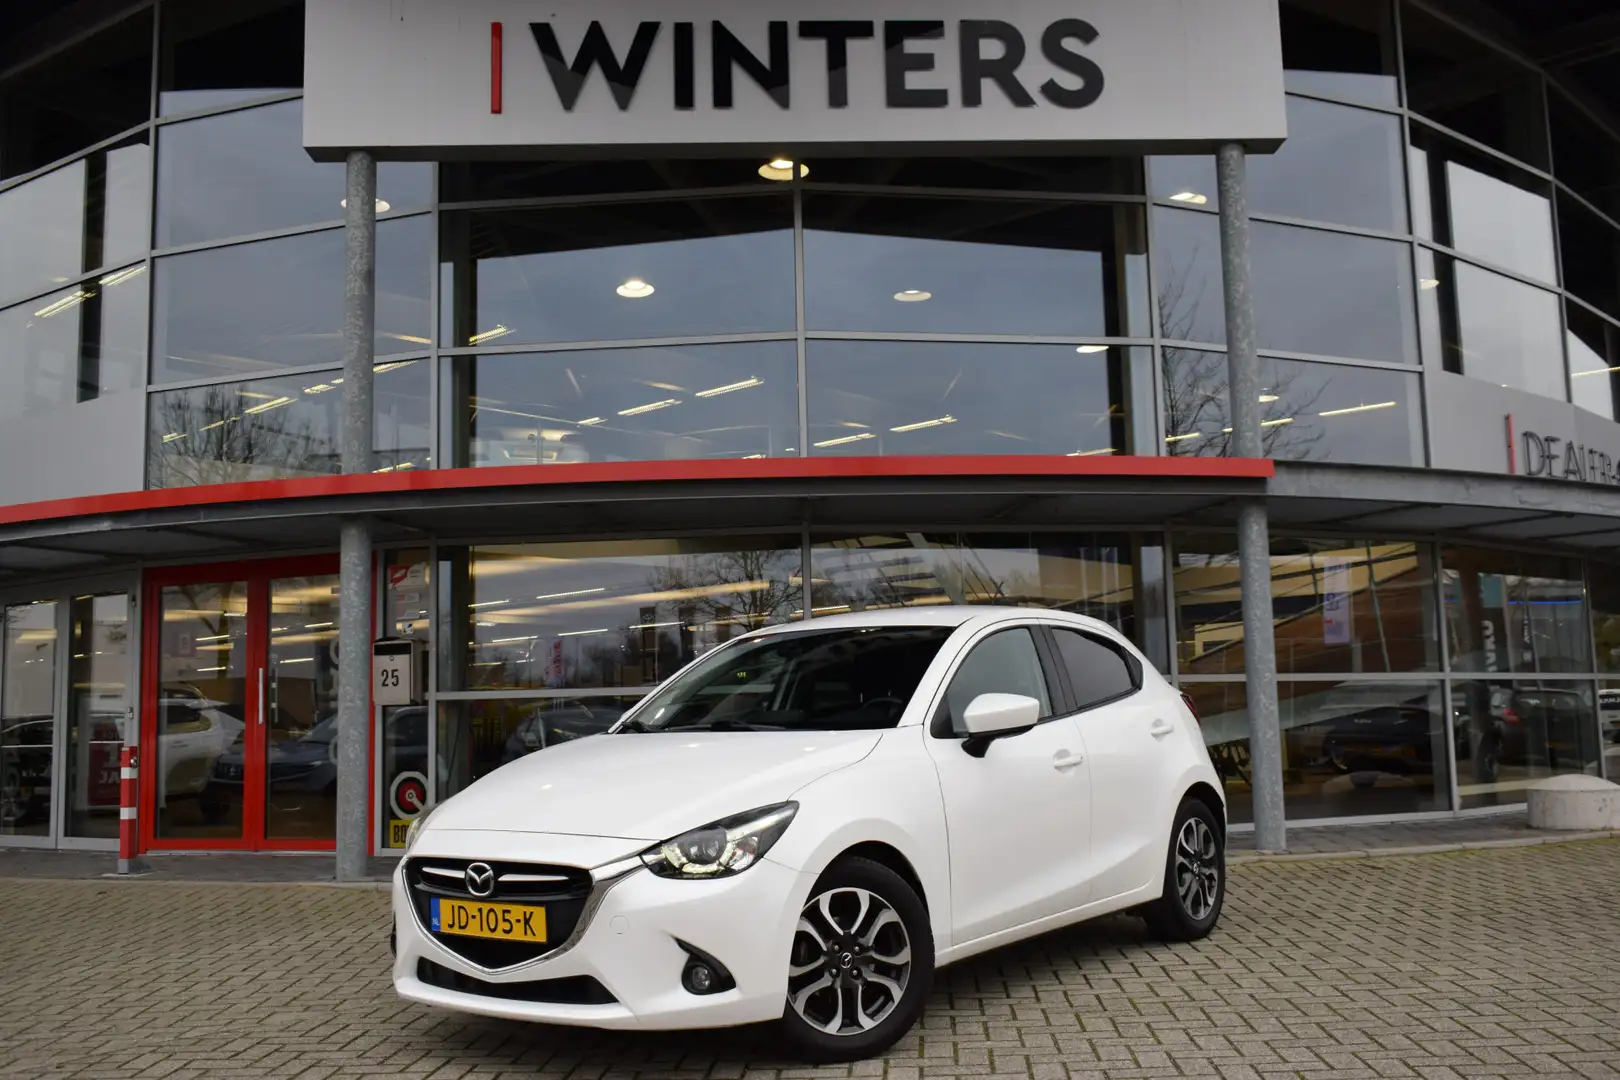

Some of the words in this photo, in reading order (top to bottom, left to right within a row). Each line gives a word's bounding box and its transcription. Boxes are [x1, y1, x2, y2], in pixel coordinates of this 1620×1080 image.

[529, 18, 1104, 112] WINTERS
[381, 668, 399, 687] 25
[393, 824, 412, 843] BO
[432, 916, 440, 926] NL
[447, 904, 537, 937] JD-105-K
